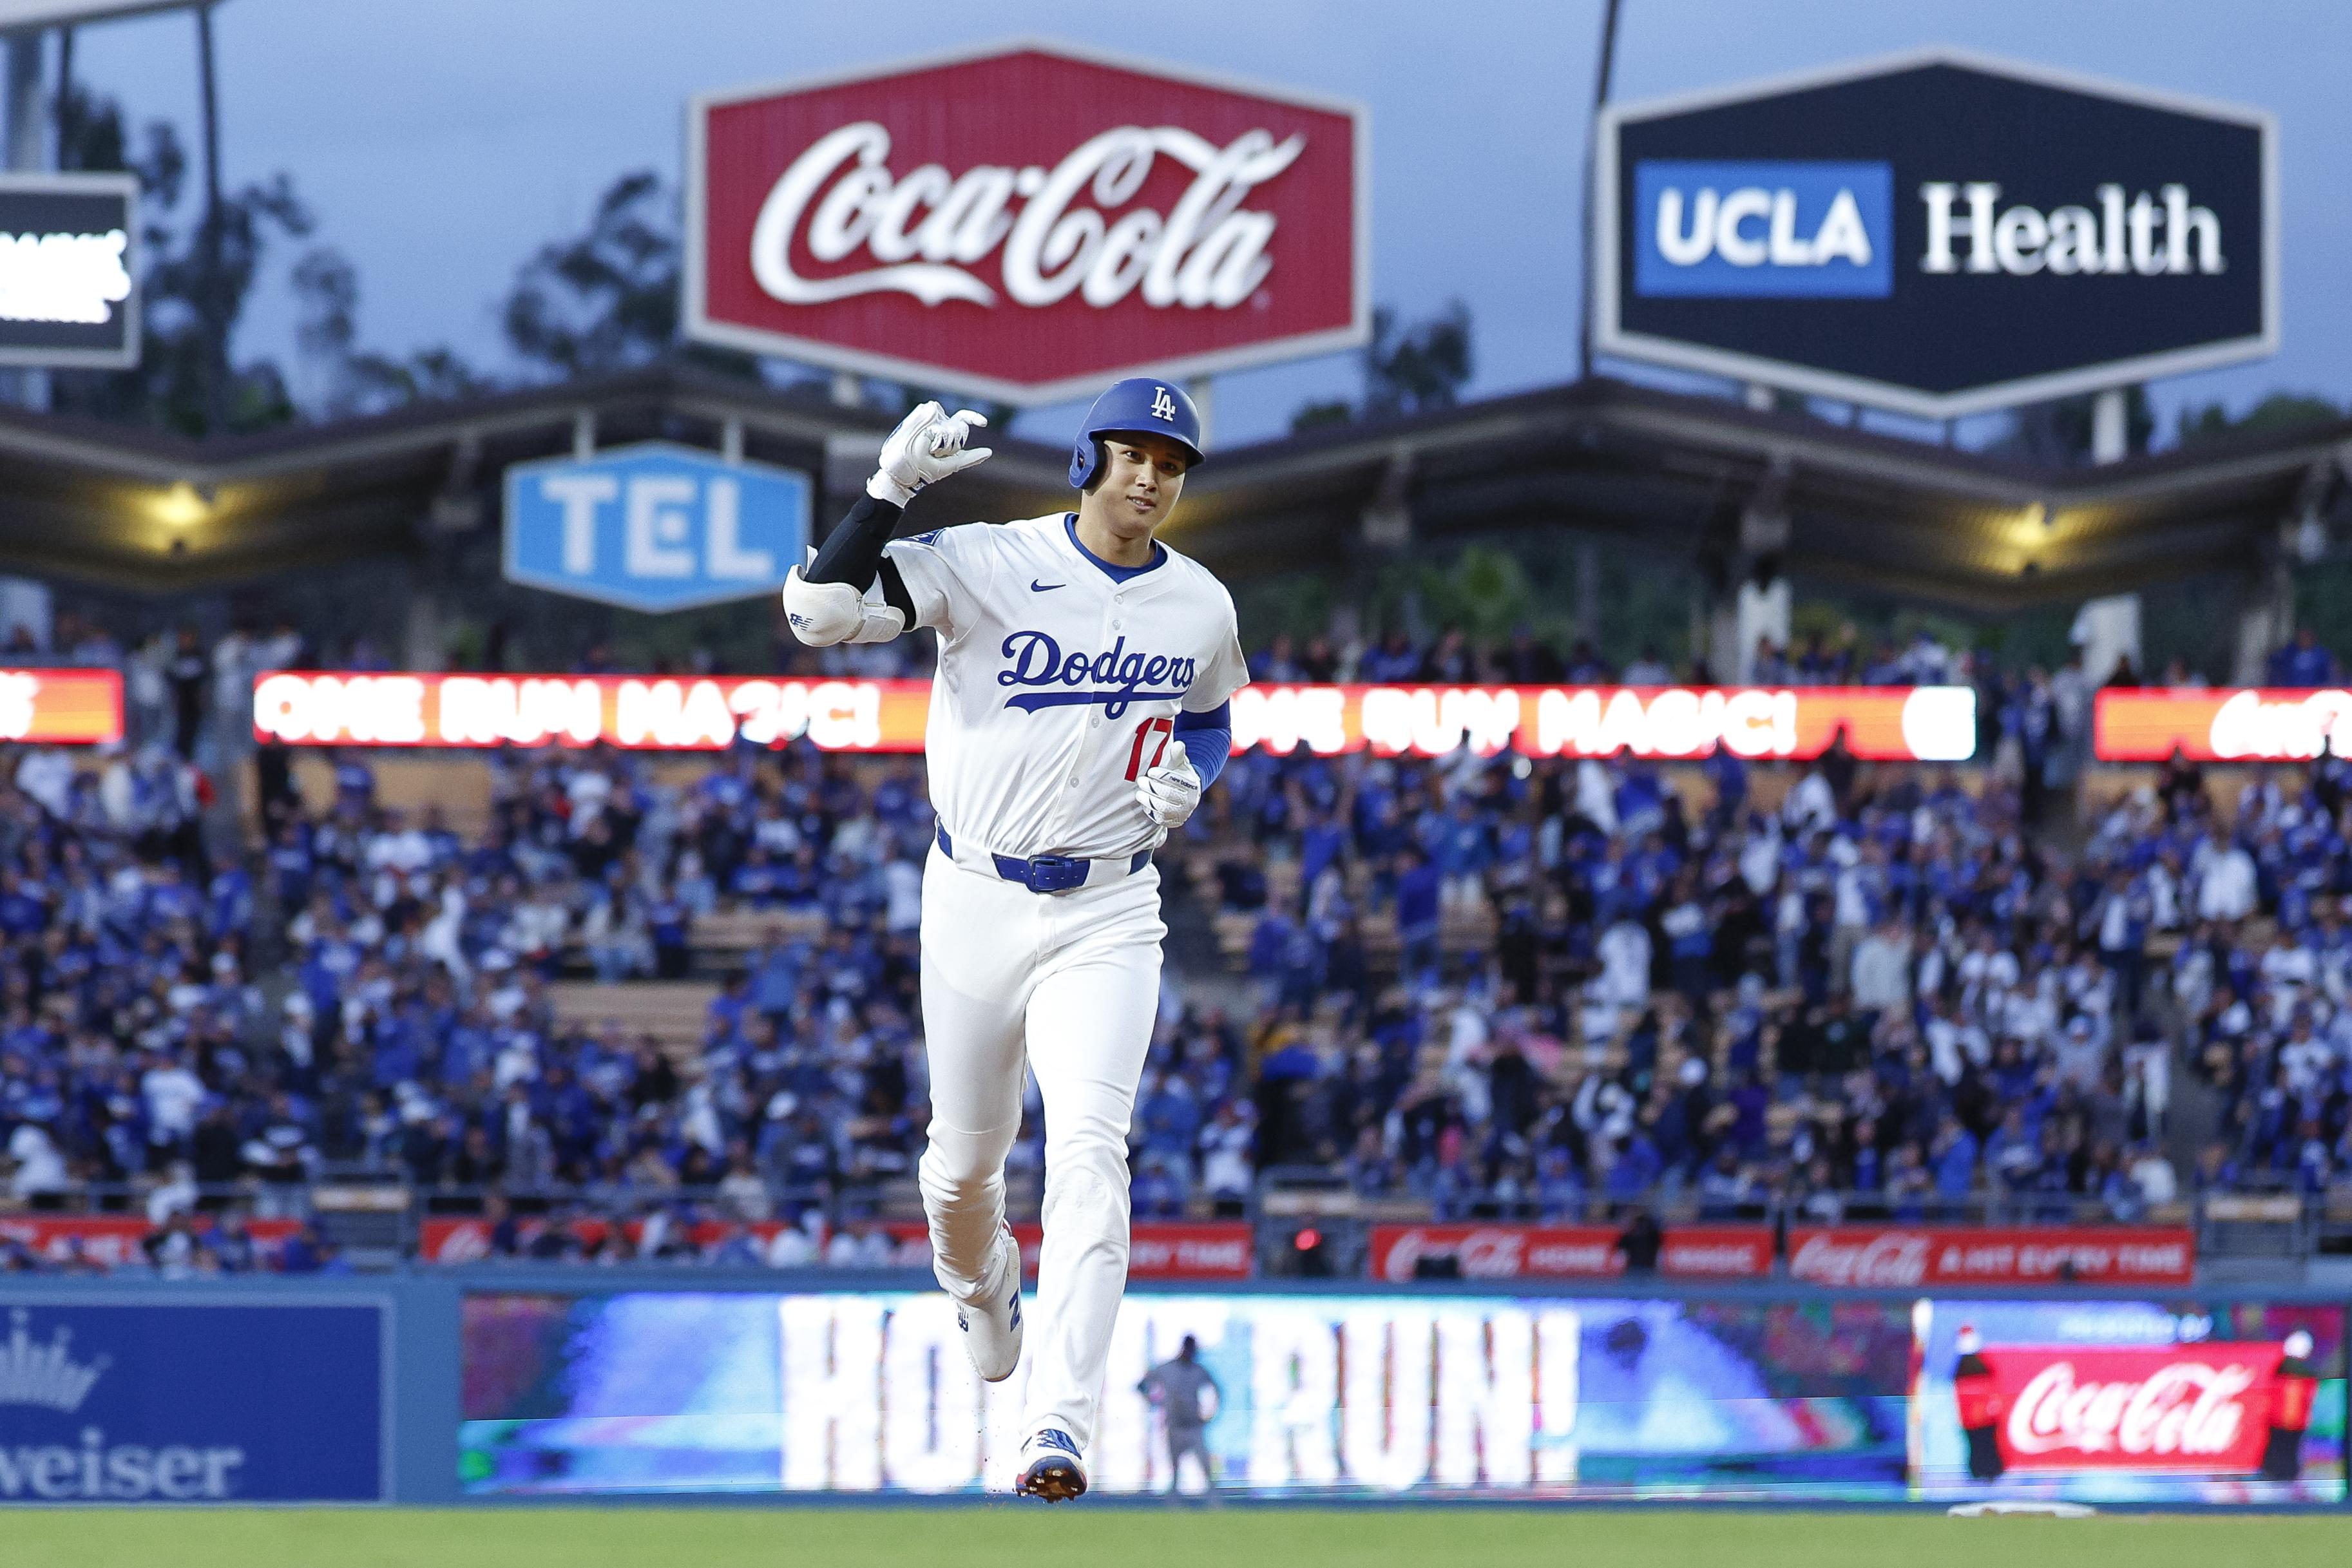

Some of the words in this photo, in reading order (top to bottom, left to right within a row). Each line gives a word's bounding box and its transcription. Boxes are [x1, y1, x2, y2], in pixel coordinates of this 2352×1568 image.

[1656, 187, 1872, 267] UCLA
[1918, 181, 2225, 275] Health
[1151, 386, 1176, 422] LA
[541, 473, 774, 577] TEL
[254, 675, 424, 743] ONE
[440, 678, 603, 743] RUN
[997, 630, 1196, 720] Dodgers
[1123, 716, 1173, 783] 17
[1248, 1308, 1582, 1492] RUN!
